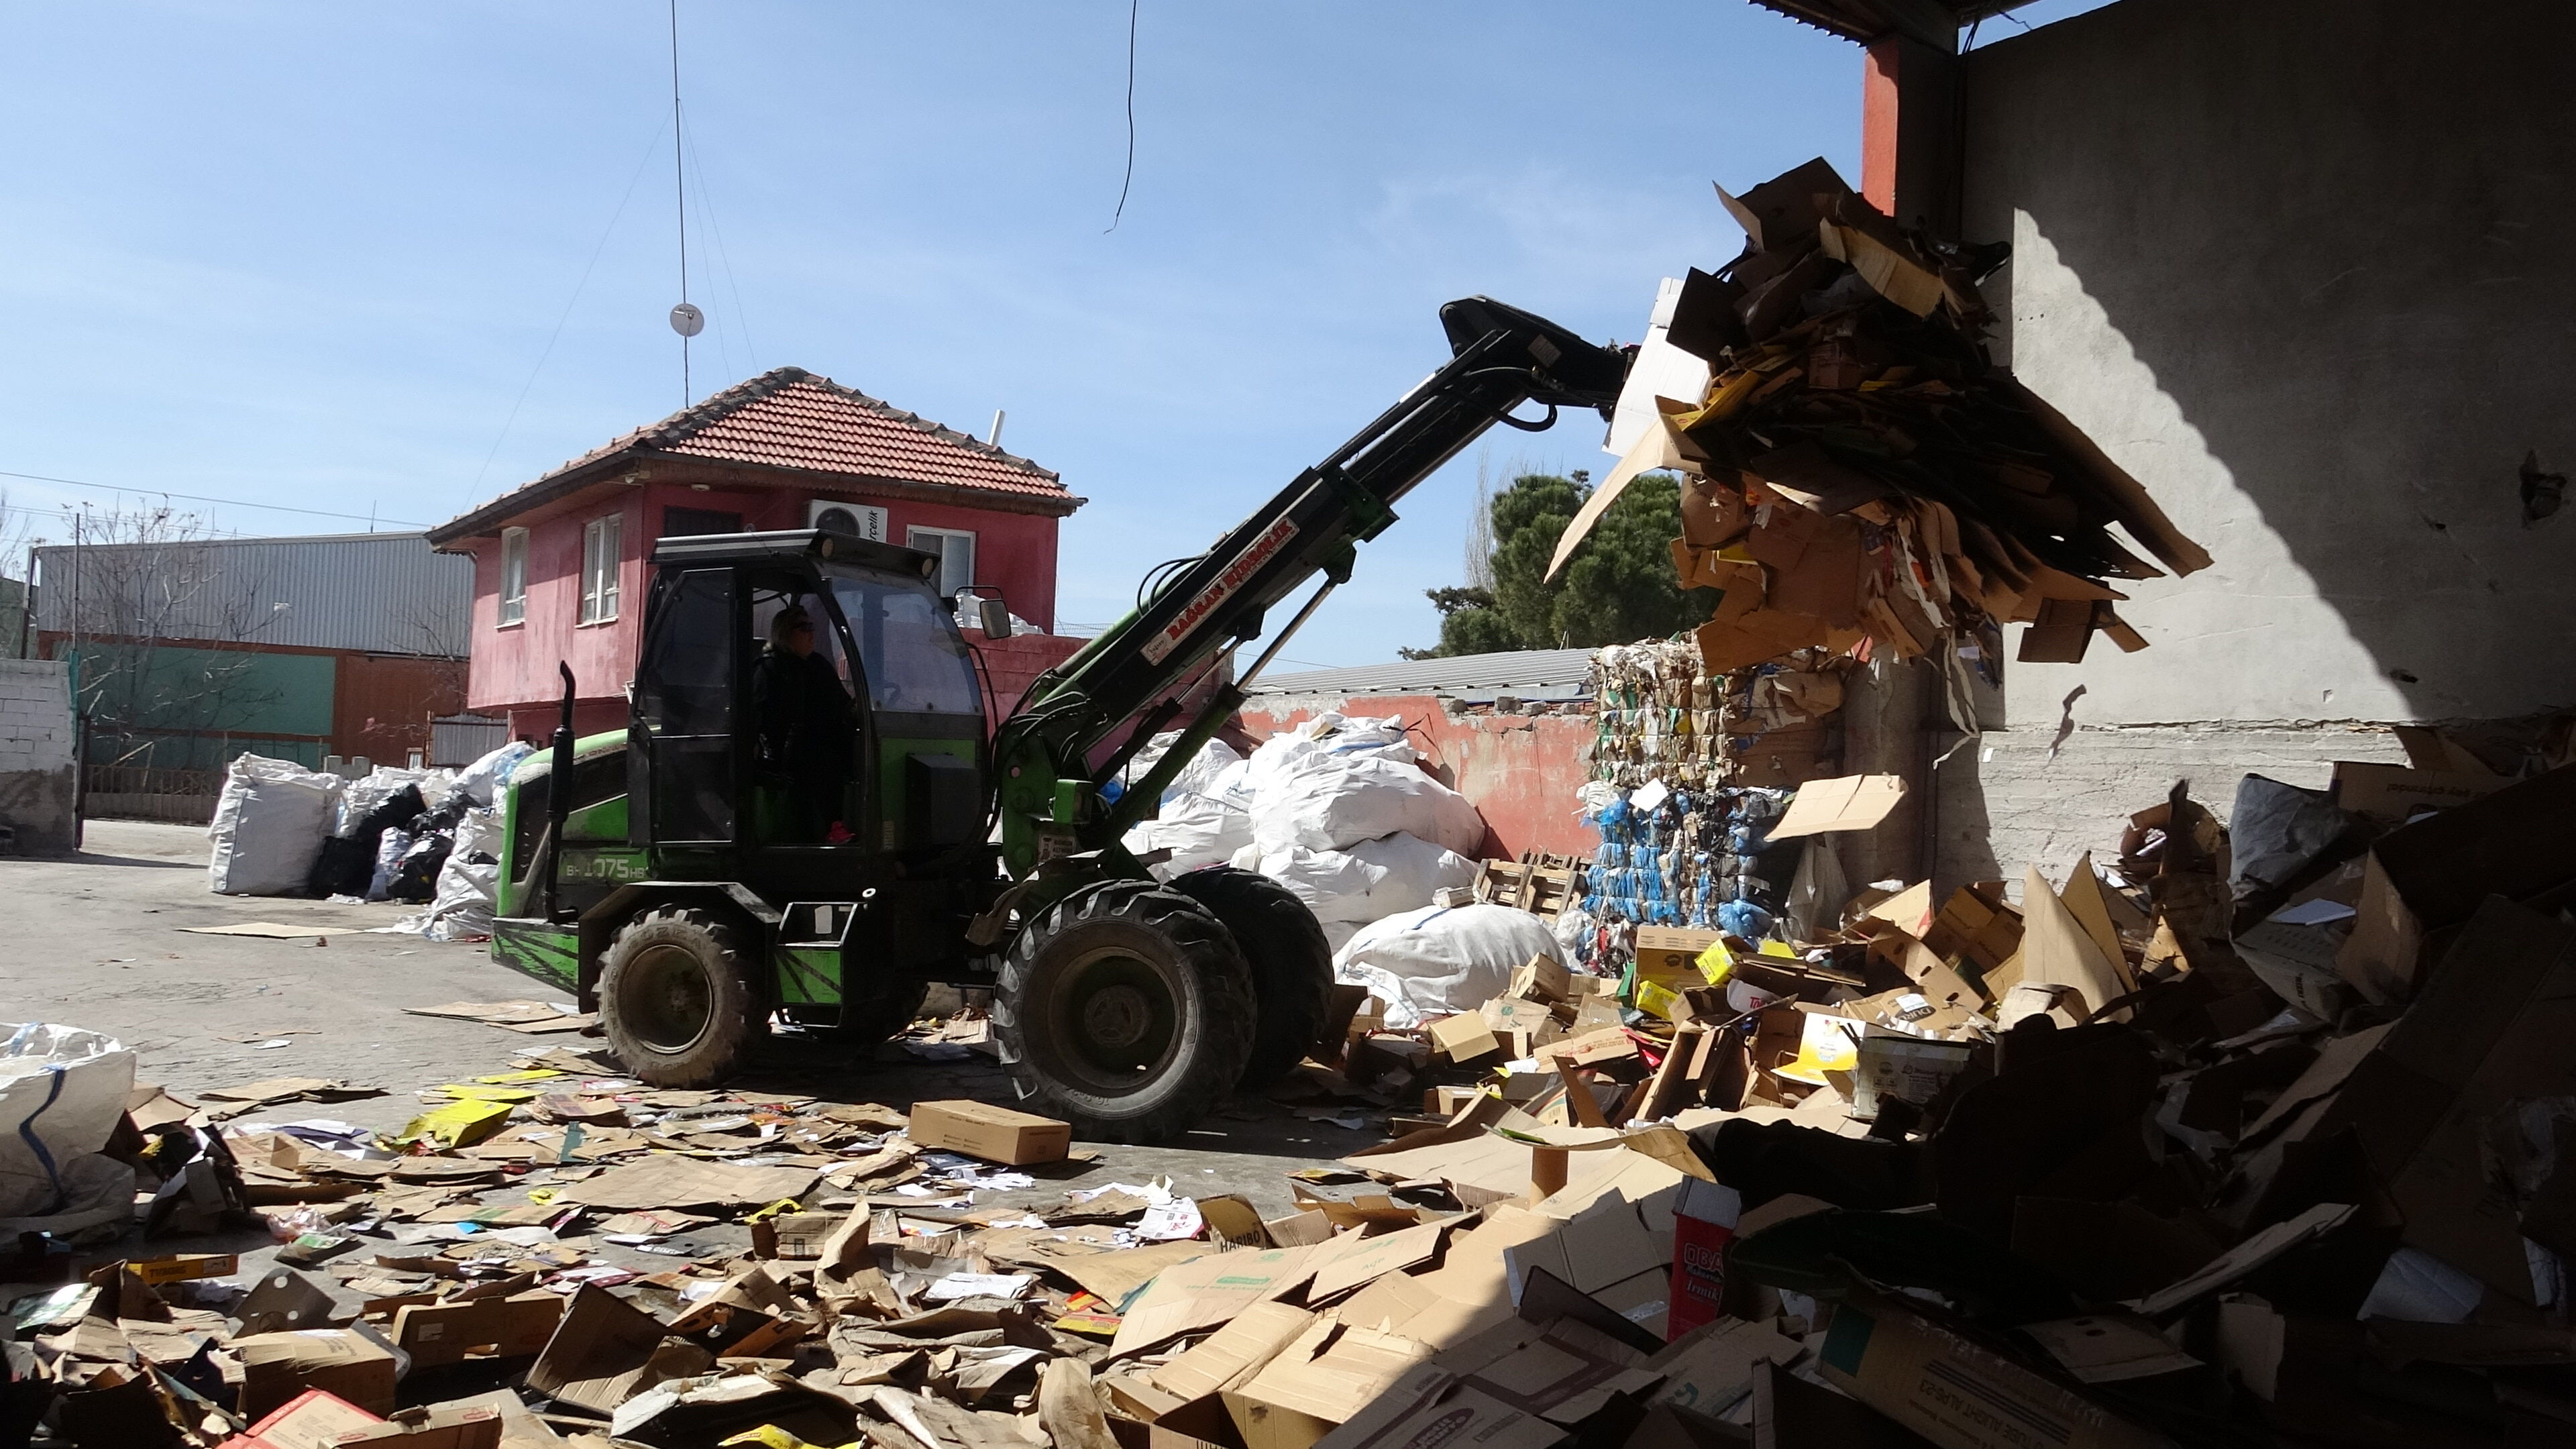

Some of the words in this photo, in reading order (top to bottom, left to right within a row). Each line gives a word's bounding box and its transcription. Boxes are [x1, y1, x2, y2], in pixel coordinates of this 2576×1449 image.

[869, 511, 879, 541] rçelik
[1167, 583, 1225, 641] BAĞSAN
[1222, 520, 1294, 589] HİDROLİK
[584, 858, 629, 879] 1075
[1220, 1230, 1261, 1253] HARIBO
[1684, 1242, 1725, 1277] OBA
